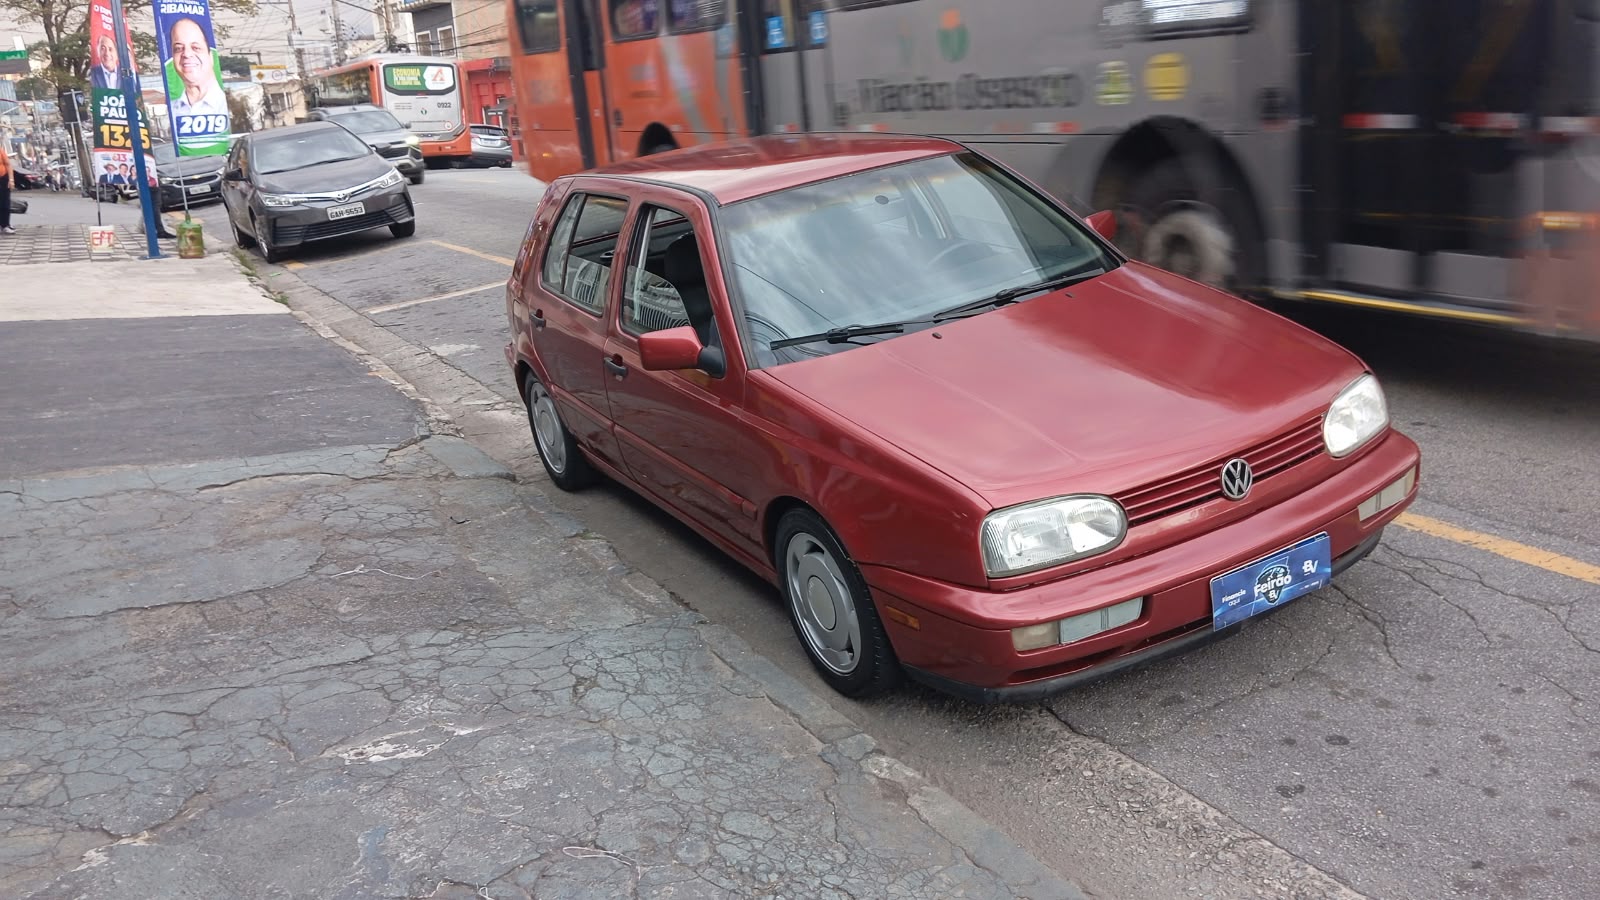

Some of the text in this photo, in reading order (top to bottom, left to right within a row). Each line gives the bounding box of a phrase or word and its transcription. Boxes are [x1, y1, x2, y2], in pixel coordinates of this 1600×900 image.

[160, 4, 205, 16] RIBAMAR
[179, 114, 227, 134] 2019
[1253, 573, 1292, 597] Feirão
[1221, 588, 1246, 603] Financie
